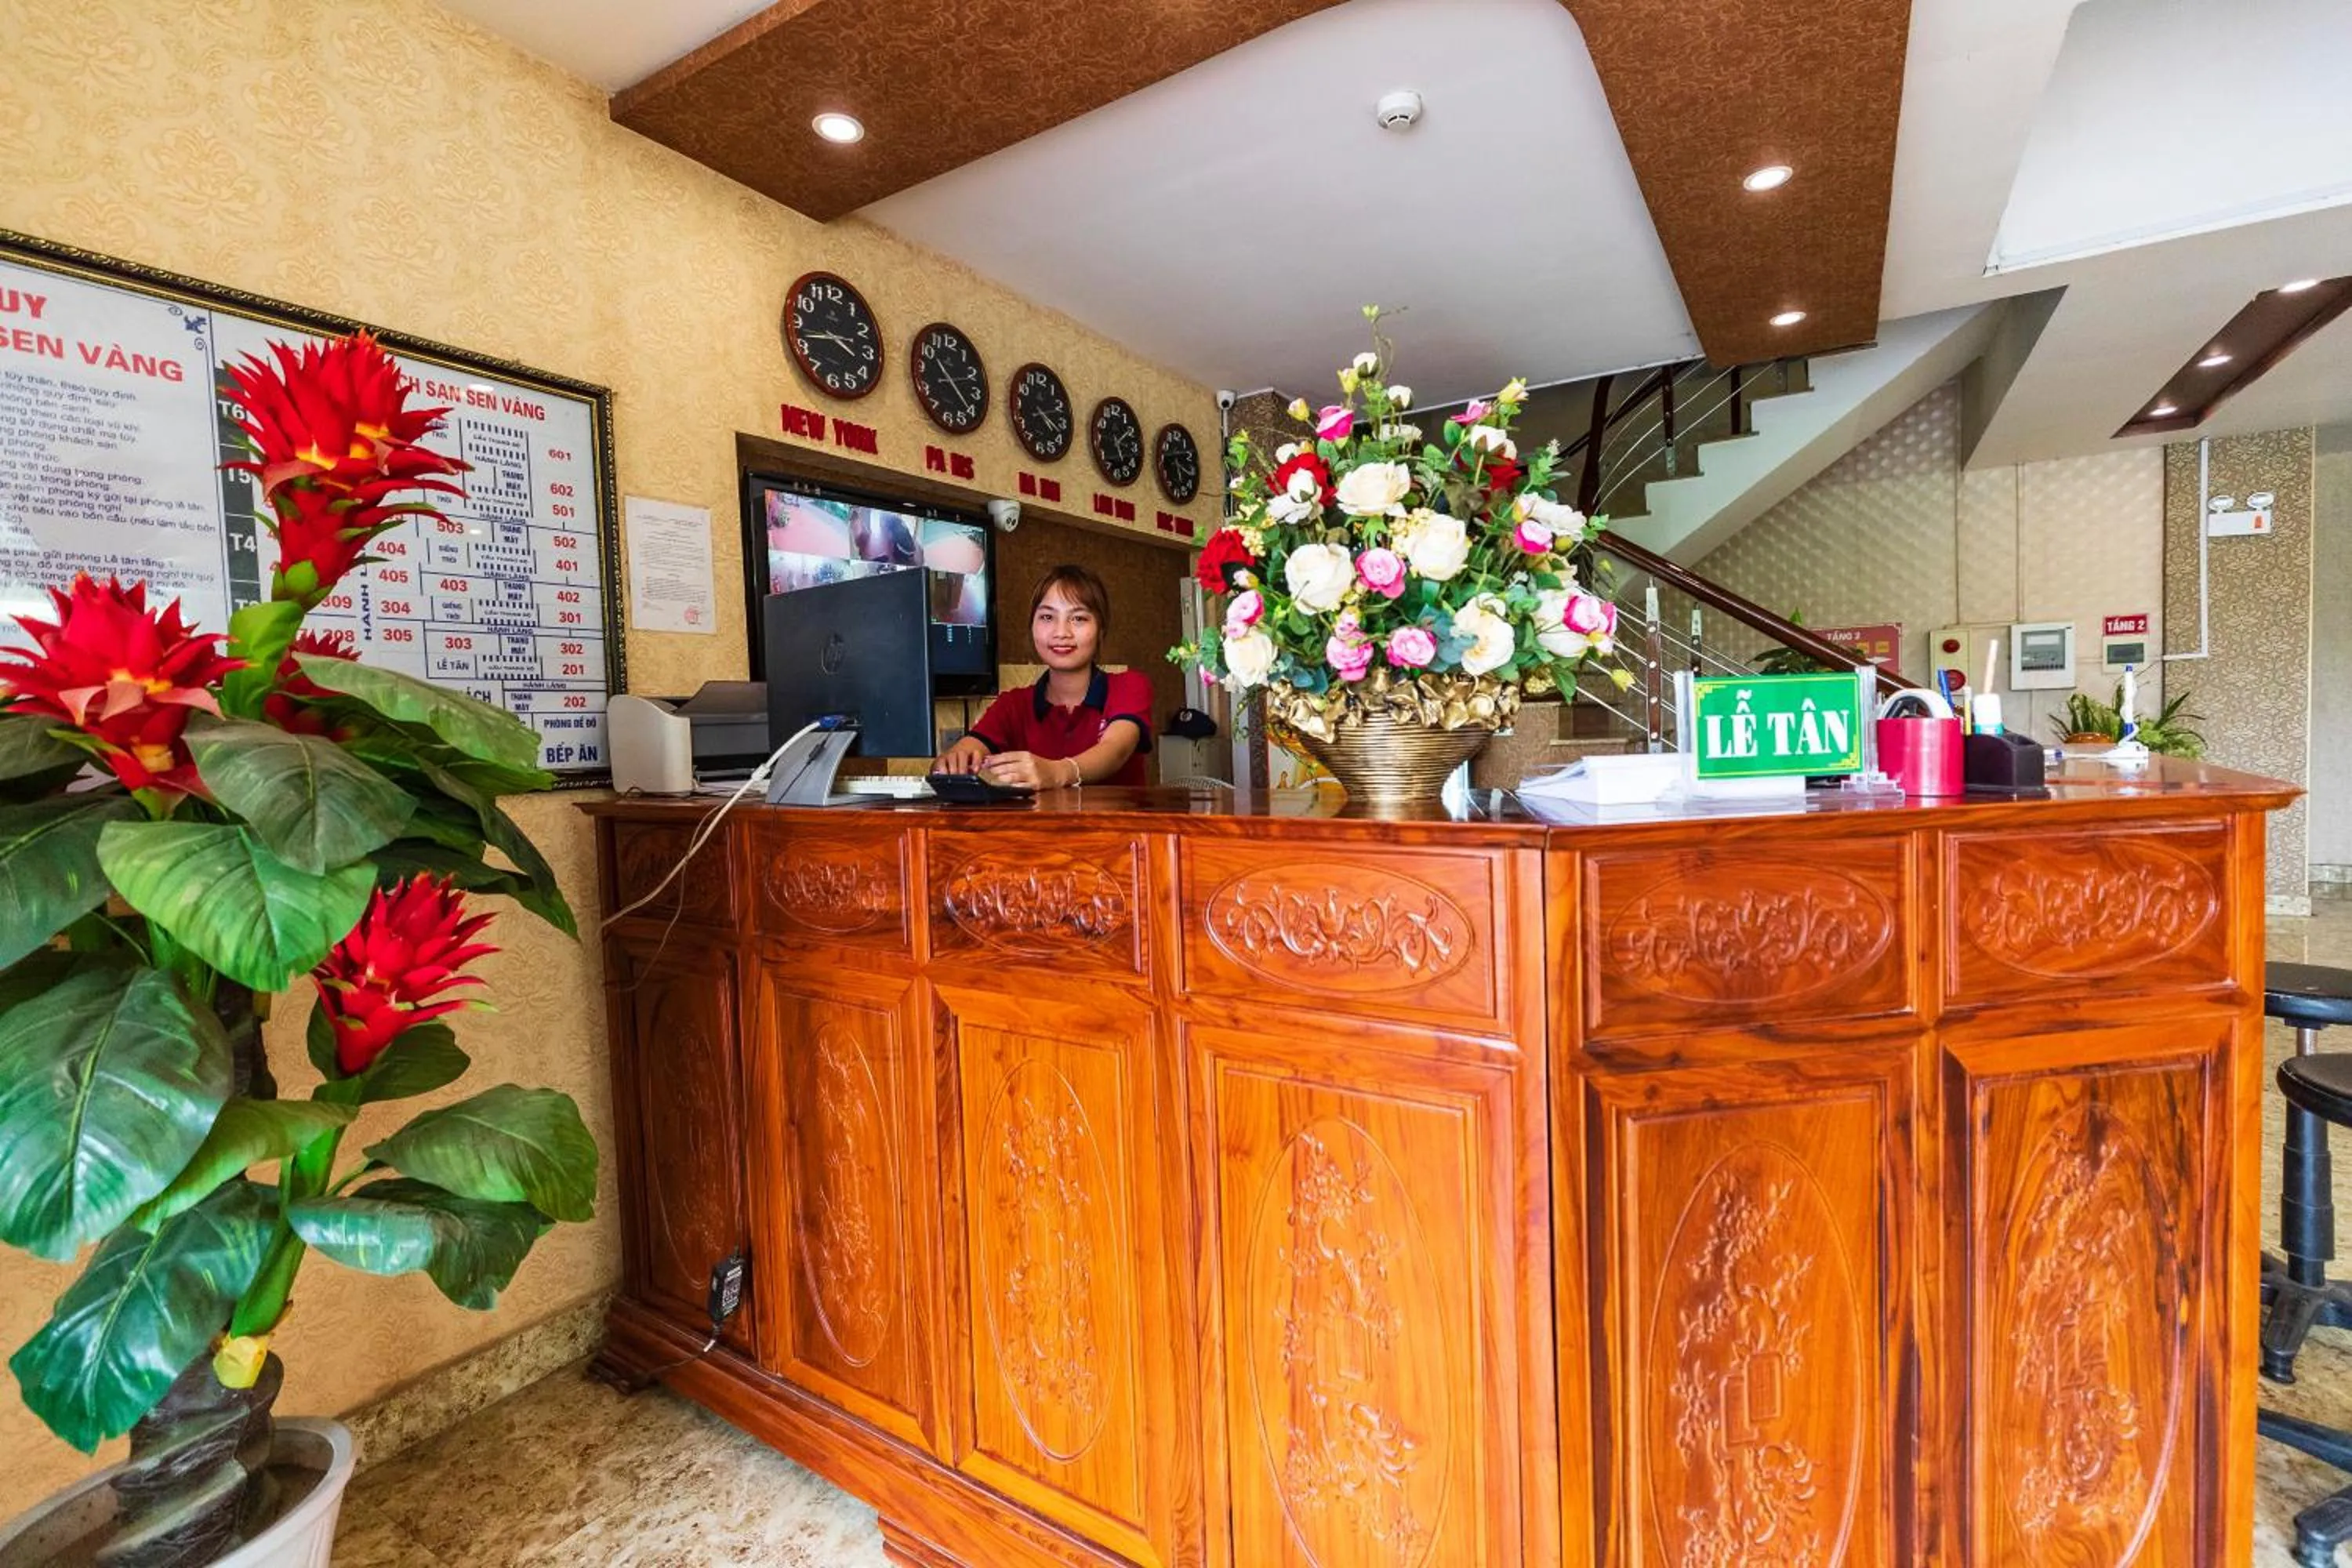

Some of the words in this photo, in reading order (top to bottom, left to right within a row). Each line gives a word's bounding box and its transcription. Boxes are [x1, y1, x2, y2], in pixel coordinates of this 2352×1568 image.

[811, 283, 822, 301] 11
[825, 285, 844, 304] 12
[798, 294, 815, 313] 10
[848, 302, 855, 317] 1
[857, 322, 869, 339] 2
[945, 334, 957, 351] 12
[862, 345, 874, 361] 3
[922, 342, 935, 359] 10
[961, 349, 967, 362] 1
[77, 342, 183, 382] VÀNG
[809, 358, 821, 371] 7
[857, 365, 867, 379] 4
[967, 366, 978, 381] 2
[827, 373, 840, 389] 6
[844, 372, 857, 389] 5
[426, 380, 461, 405] SẠN
[466, 387, 497, 410] SEN
[971, 387, 981, 400] 3
[218, 400, 246, 420] T6
[929, 397, 939, 409] 7
[967, 404, 975, 417] 4
[943, 412, 953, 426] 6
[956, 410, 967, 426] 5
[549, 448, 572, 461] 601
[550, 482, 575, 498] 602
[553, 504, 575, 518] 501
[437, 521, 464, 535] 503
[230, 533, 256, 553] T4
[376, 541, 407, 556] 404
[554, 535, 577, 550] 502
[556, 560, 578, 572] 401
[379, 569, 408, 583] 405
[441, 578, 468, 593] 403
[557, 590, 580, 603] 402
[381, 600, 411, 615] 304
[559, 612, 582, 624] 301
[2137, 619, 2145, 630] 2
[383, 628, 413, 643] 305
[445, 637, 473, 650] 303
[561, 643, 583, 655] 302
[562, 663, 585, 676] 201
[564, 696, 586, 709] 202
[1704, 689, 1757, 758] LỄ
[1767, 698, 1849, 756] TÂN
